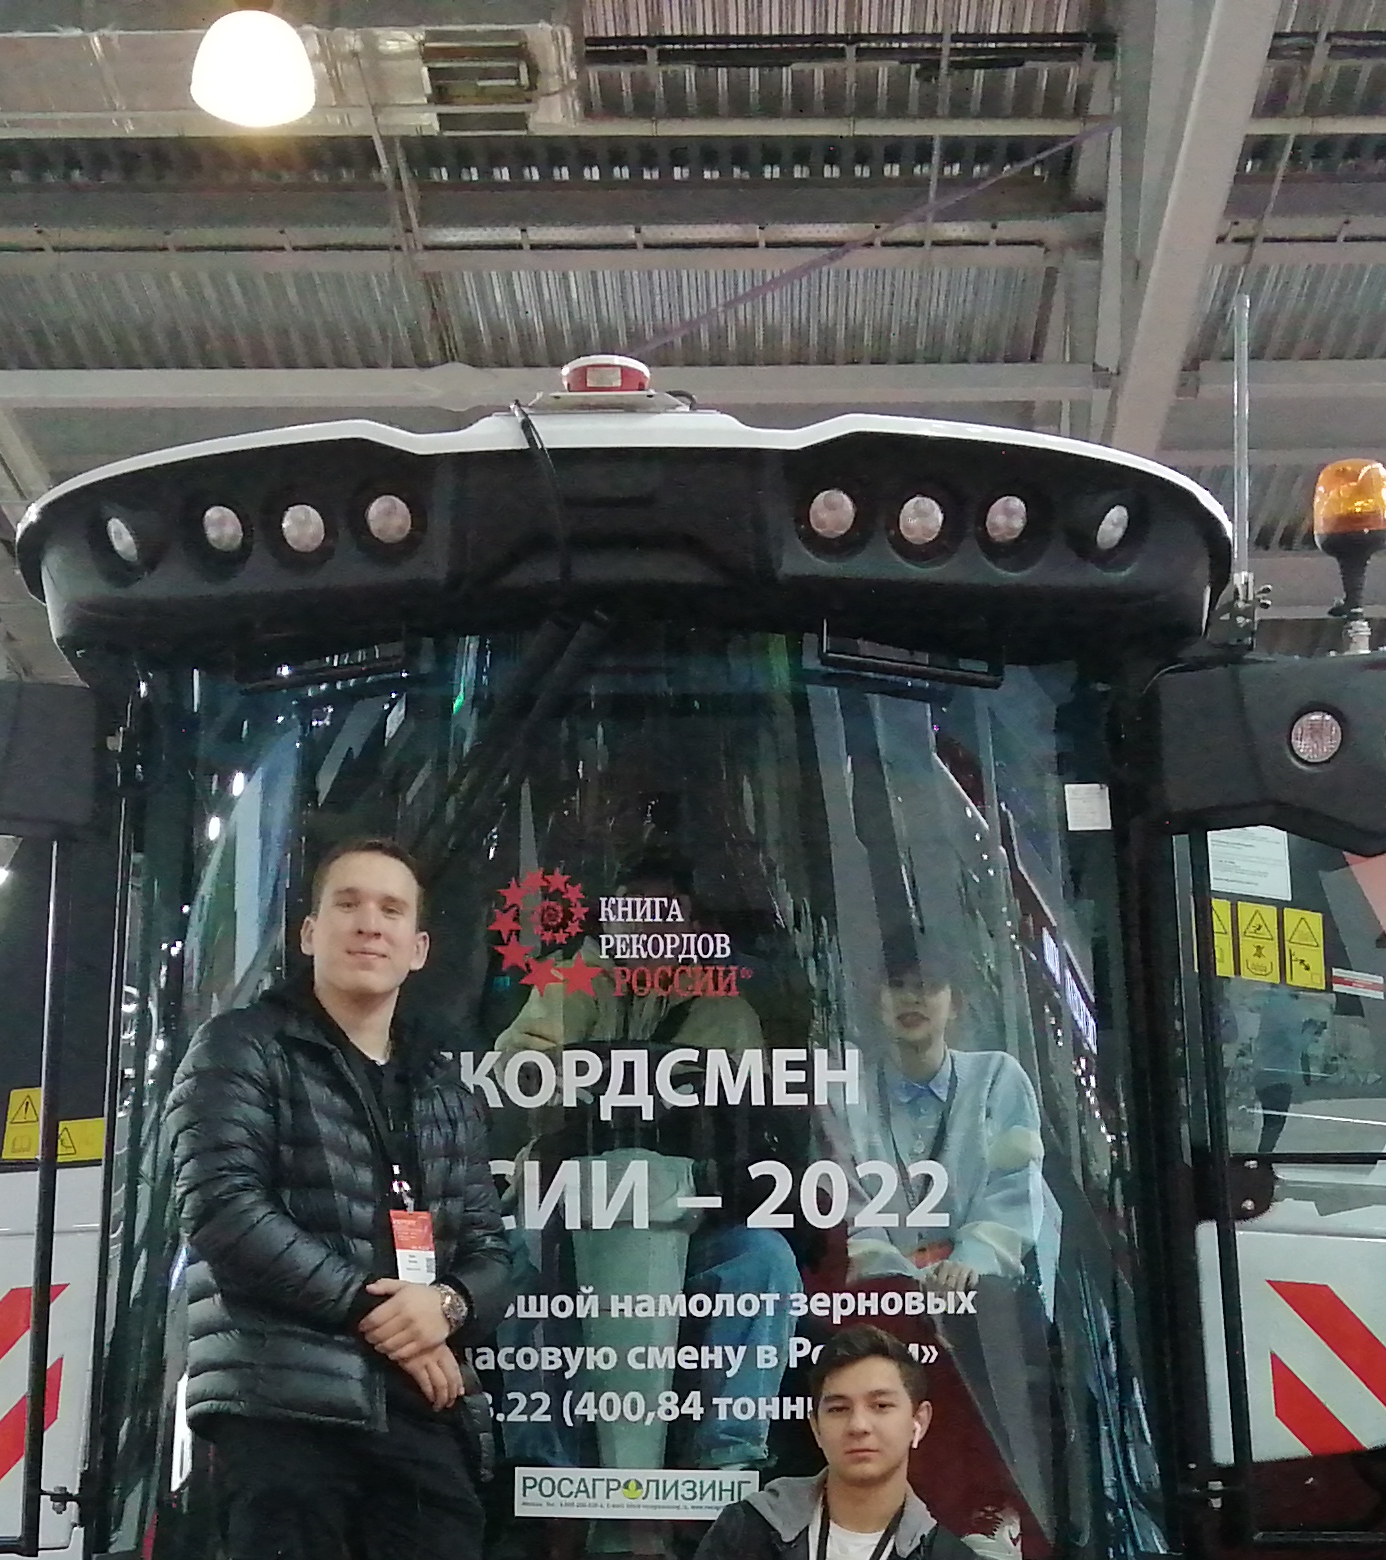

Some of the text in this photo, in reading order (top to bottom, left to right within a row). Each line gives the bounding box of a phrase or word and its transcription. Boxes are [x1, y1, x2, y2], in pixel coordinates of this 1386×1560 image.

[598, 896, 685, 922] КНИГА
[598, 933, 731, 964] РЕКОРДОВ
[441, 1047, 860, 1121] КОРДСМЕН
[746, 1160, 951, 1229] 2022
[610, 1291, 780, 1319] намолот
[788, 1289, 978, 1325] зерновых
[627, 1344, 747, 1379] смену
[756, 1346, 779, 1369] в
[483, 1390, 552, 1423] .22
[562, 1390, 705, 1428] (400,84
[521, 1475, 752, 1502] РОСАГРОЛИЗИНГ
